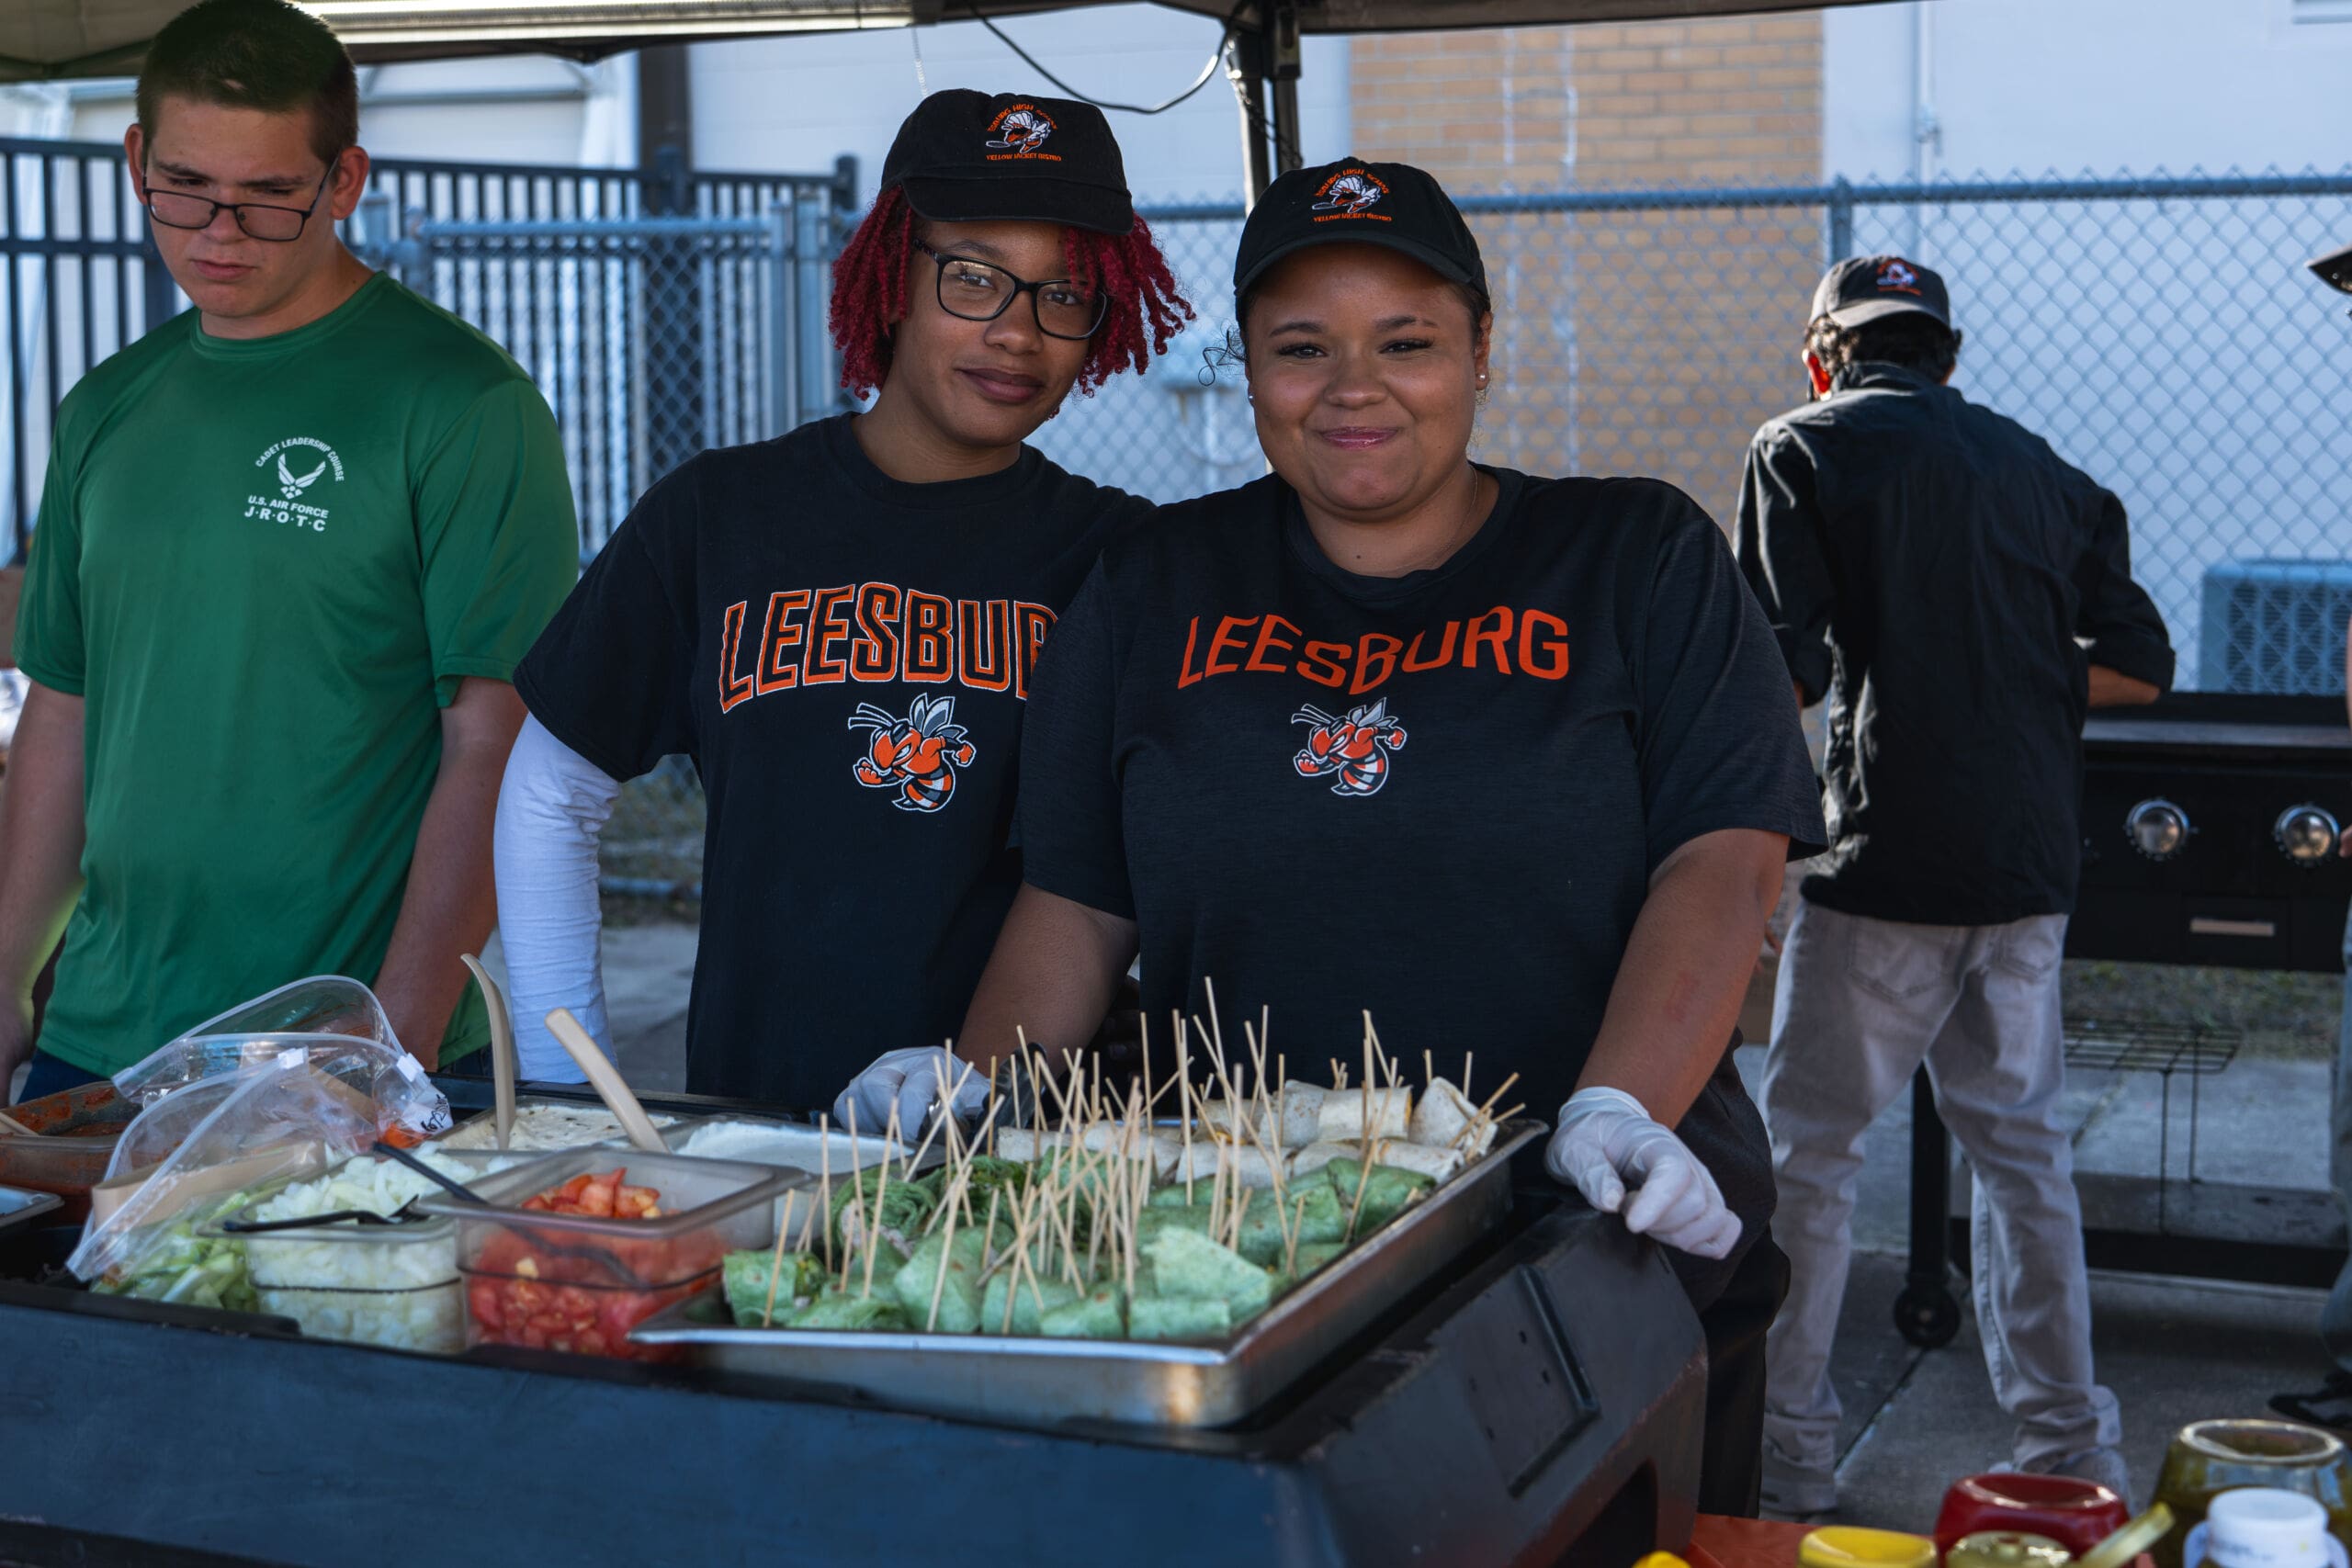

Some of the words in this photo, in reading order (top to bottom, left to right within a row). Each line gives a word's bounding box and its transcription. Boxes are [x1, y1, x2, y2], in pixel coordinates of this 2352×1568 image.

[254, 443, 281, 468] CADET
[281, 436, 332, 454] LEADERSHIP
[327, 451, 345, 482] COURSE
[247, 494, 267, 506] U.S.
[269, 499, 289, 510] AIR
[290, 502, 330, 519] FORCE
[1176, 605, 1571, 695] LEESBURG
